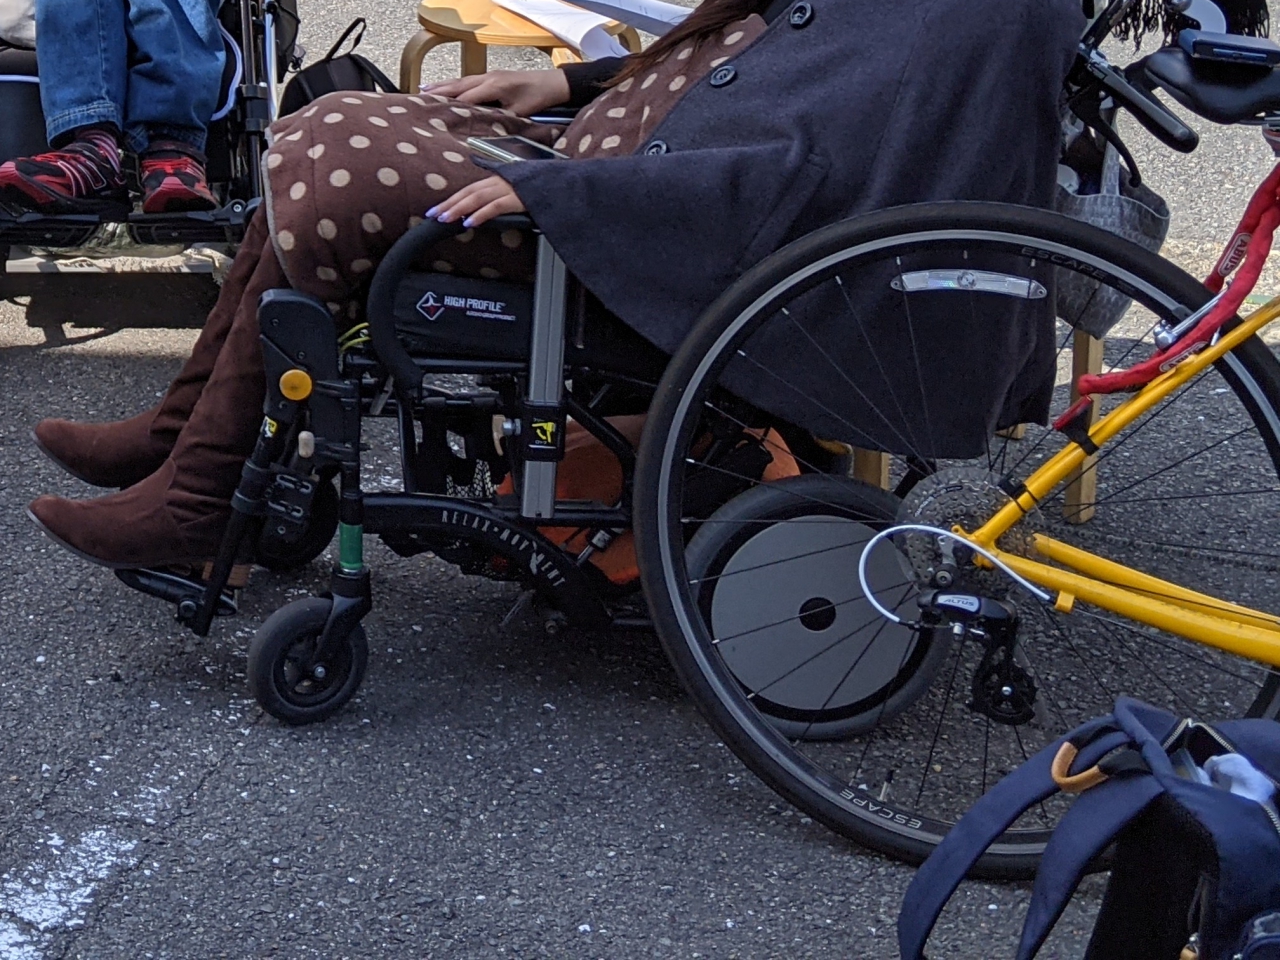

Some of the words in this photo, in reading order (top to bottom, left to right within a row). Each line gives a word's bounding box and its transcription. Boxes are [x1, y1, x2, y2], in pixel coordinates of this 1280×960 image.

[1021, 246, 1106, 280] ESCAPE
[1224, 238, 1248, 271] ABUS
[444, 295, 466, 307] HIGH
[943, 598, 975, 608] ALTUS
[840, 788, 922, 829] ESCAPE
